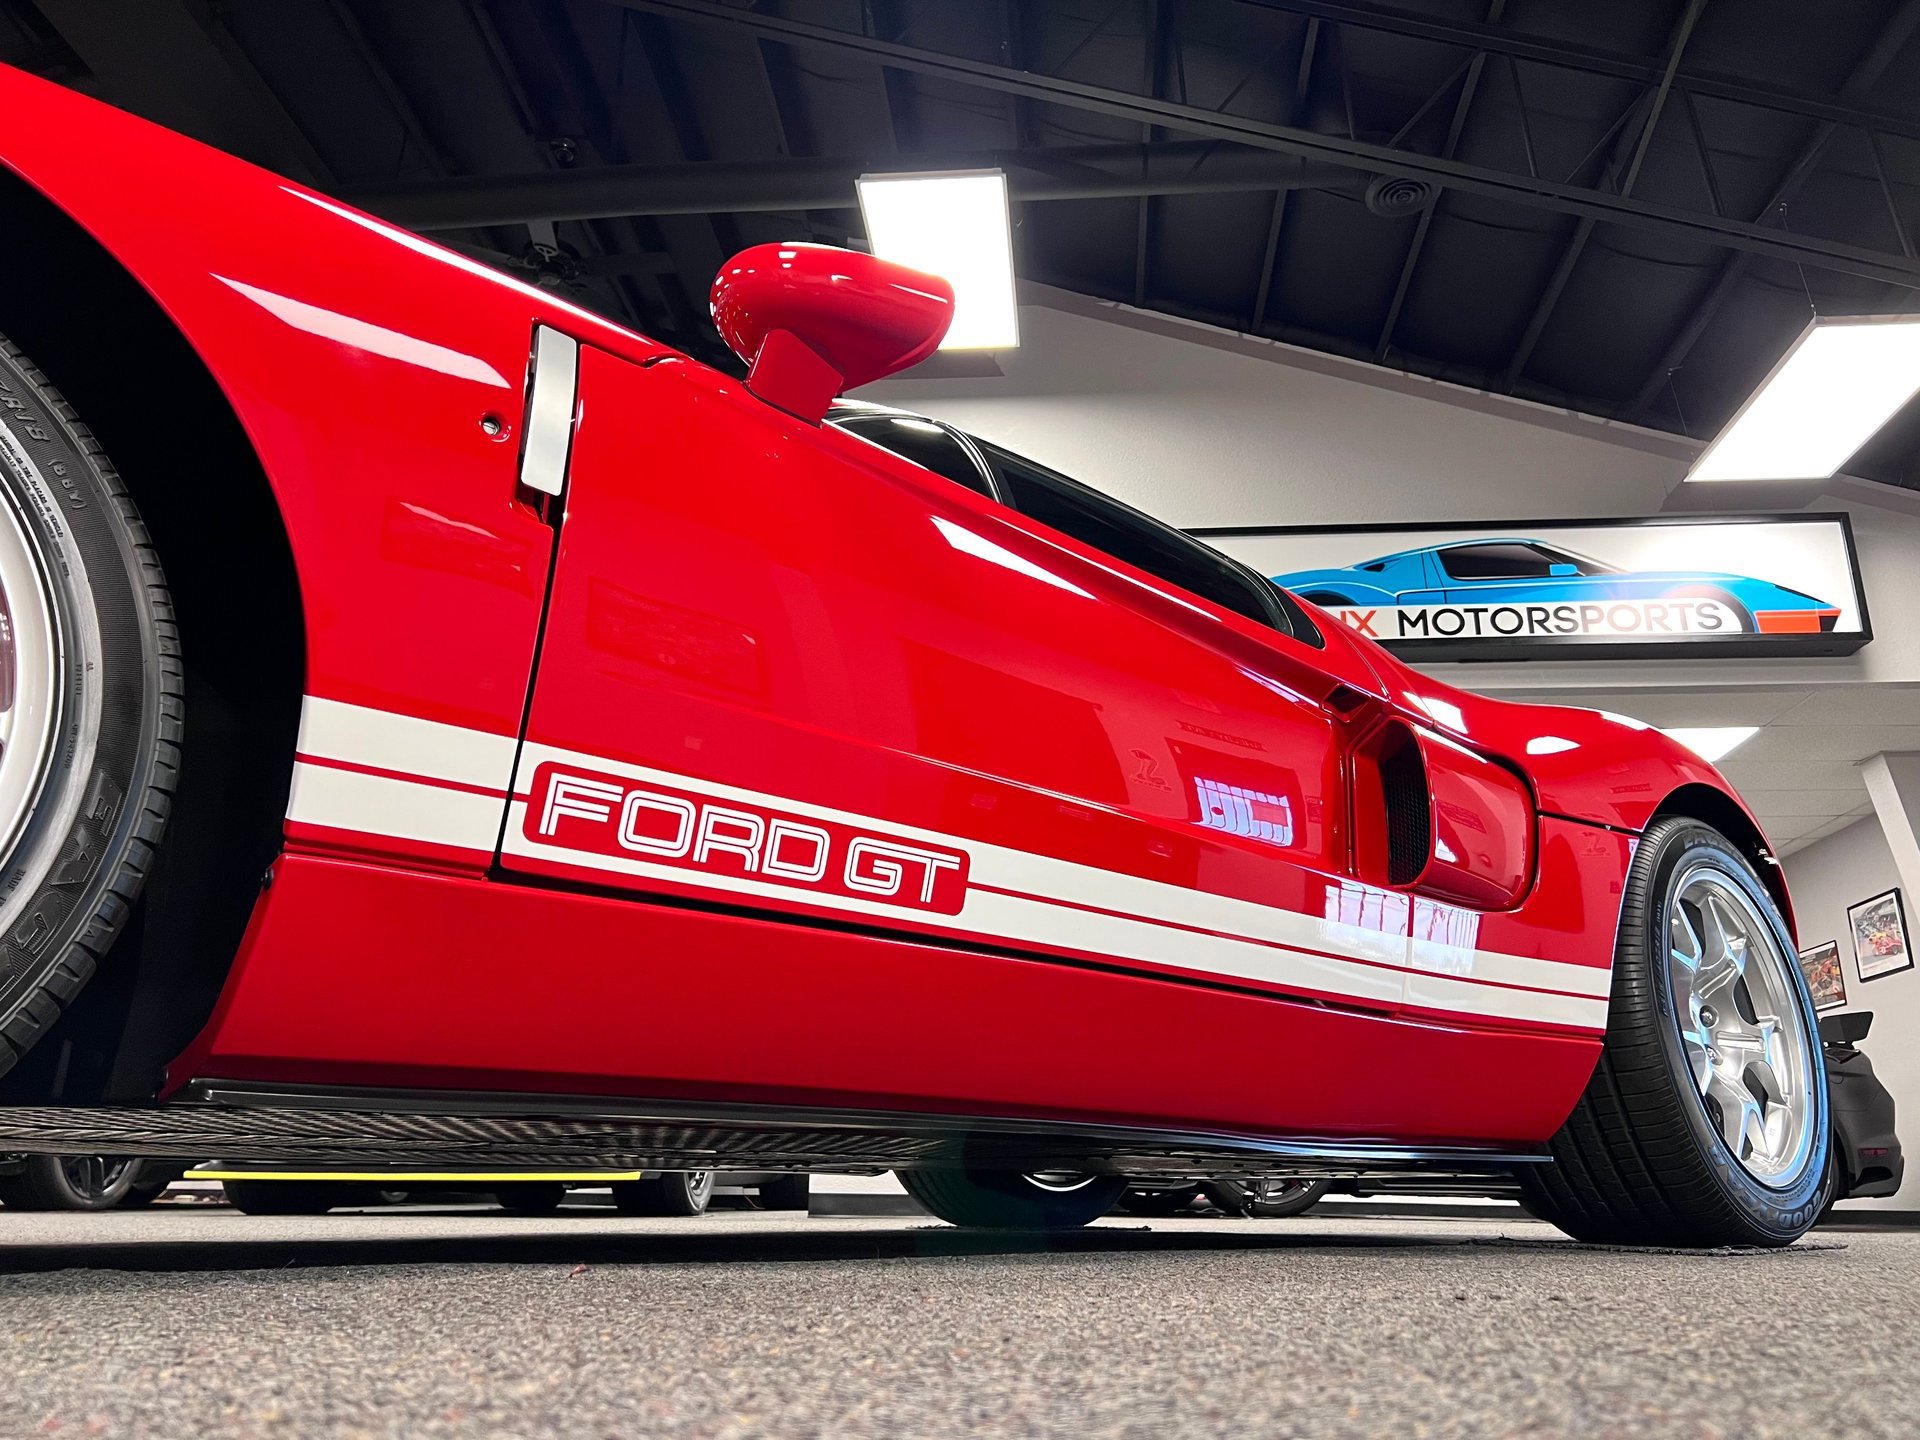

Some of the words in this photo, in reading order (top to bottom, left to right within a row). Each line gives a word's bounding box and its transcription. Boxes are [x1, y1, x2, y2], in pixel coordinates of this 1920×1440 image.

[1399, 602, 1723, 637] MOTORSPORTS
[538, 772, 831, 883] FORD
[842, 836, 961, 904] GT
